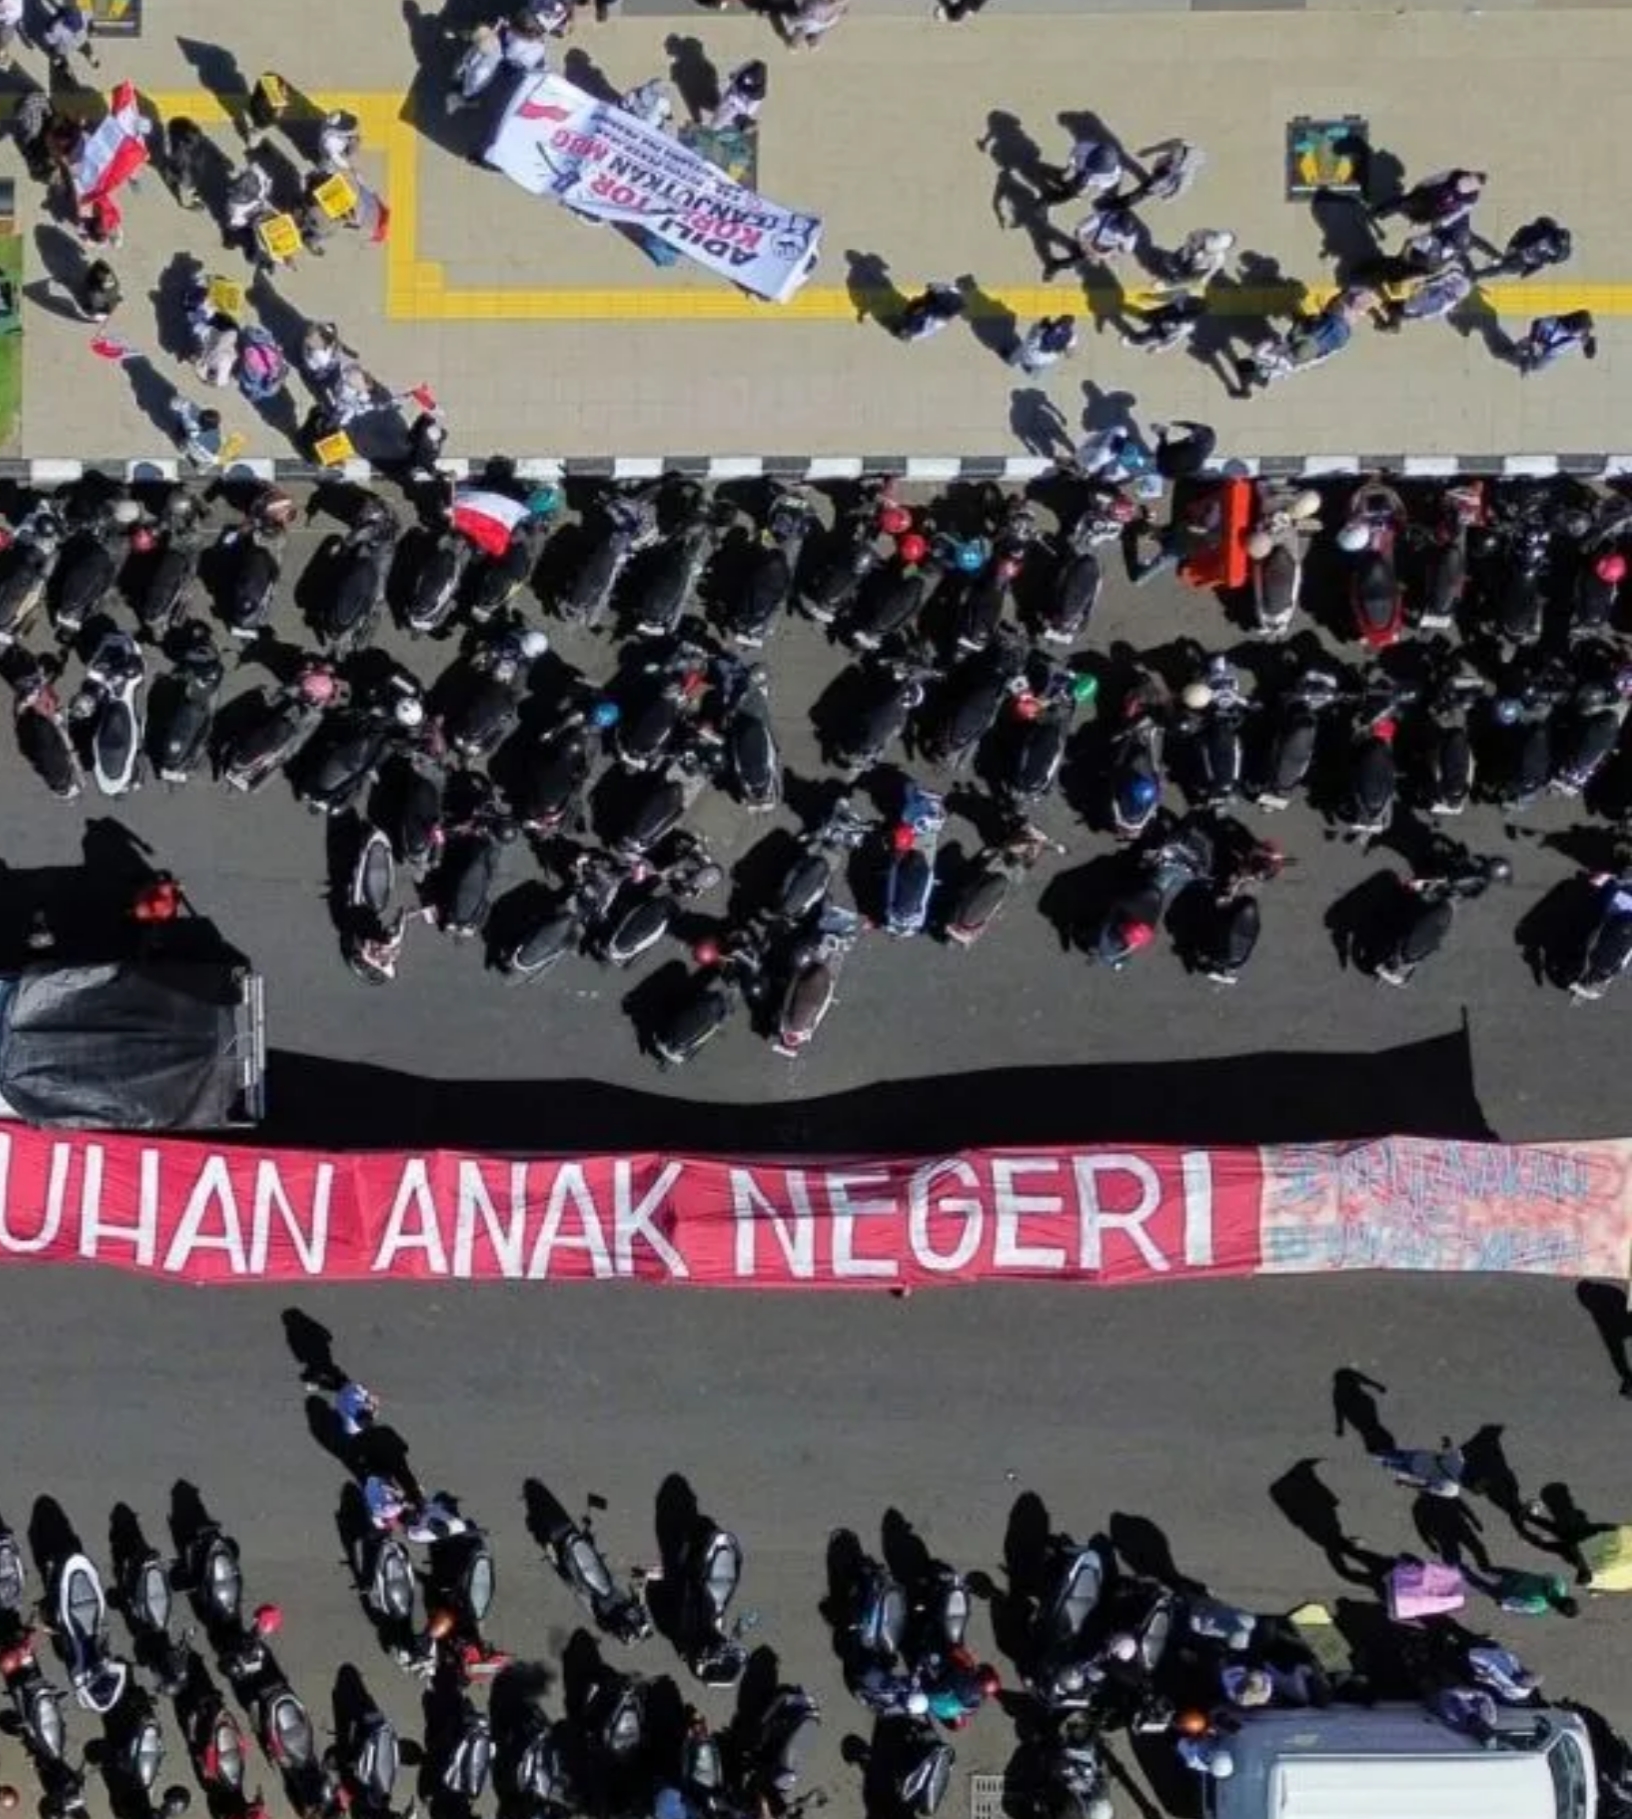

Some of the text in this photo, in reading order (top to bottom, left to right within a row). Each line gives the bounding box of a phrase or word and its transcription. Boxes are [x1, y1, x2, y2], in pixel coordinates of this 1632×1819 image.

[550, 127, 609, 162] MBG
[659, 215, 759, 267] ADILI
[372, 1158, 690, 1279] ANAK
[728, 1150, 1214, 1277] NEGERI
